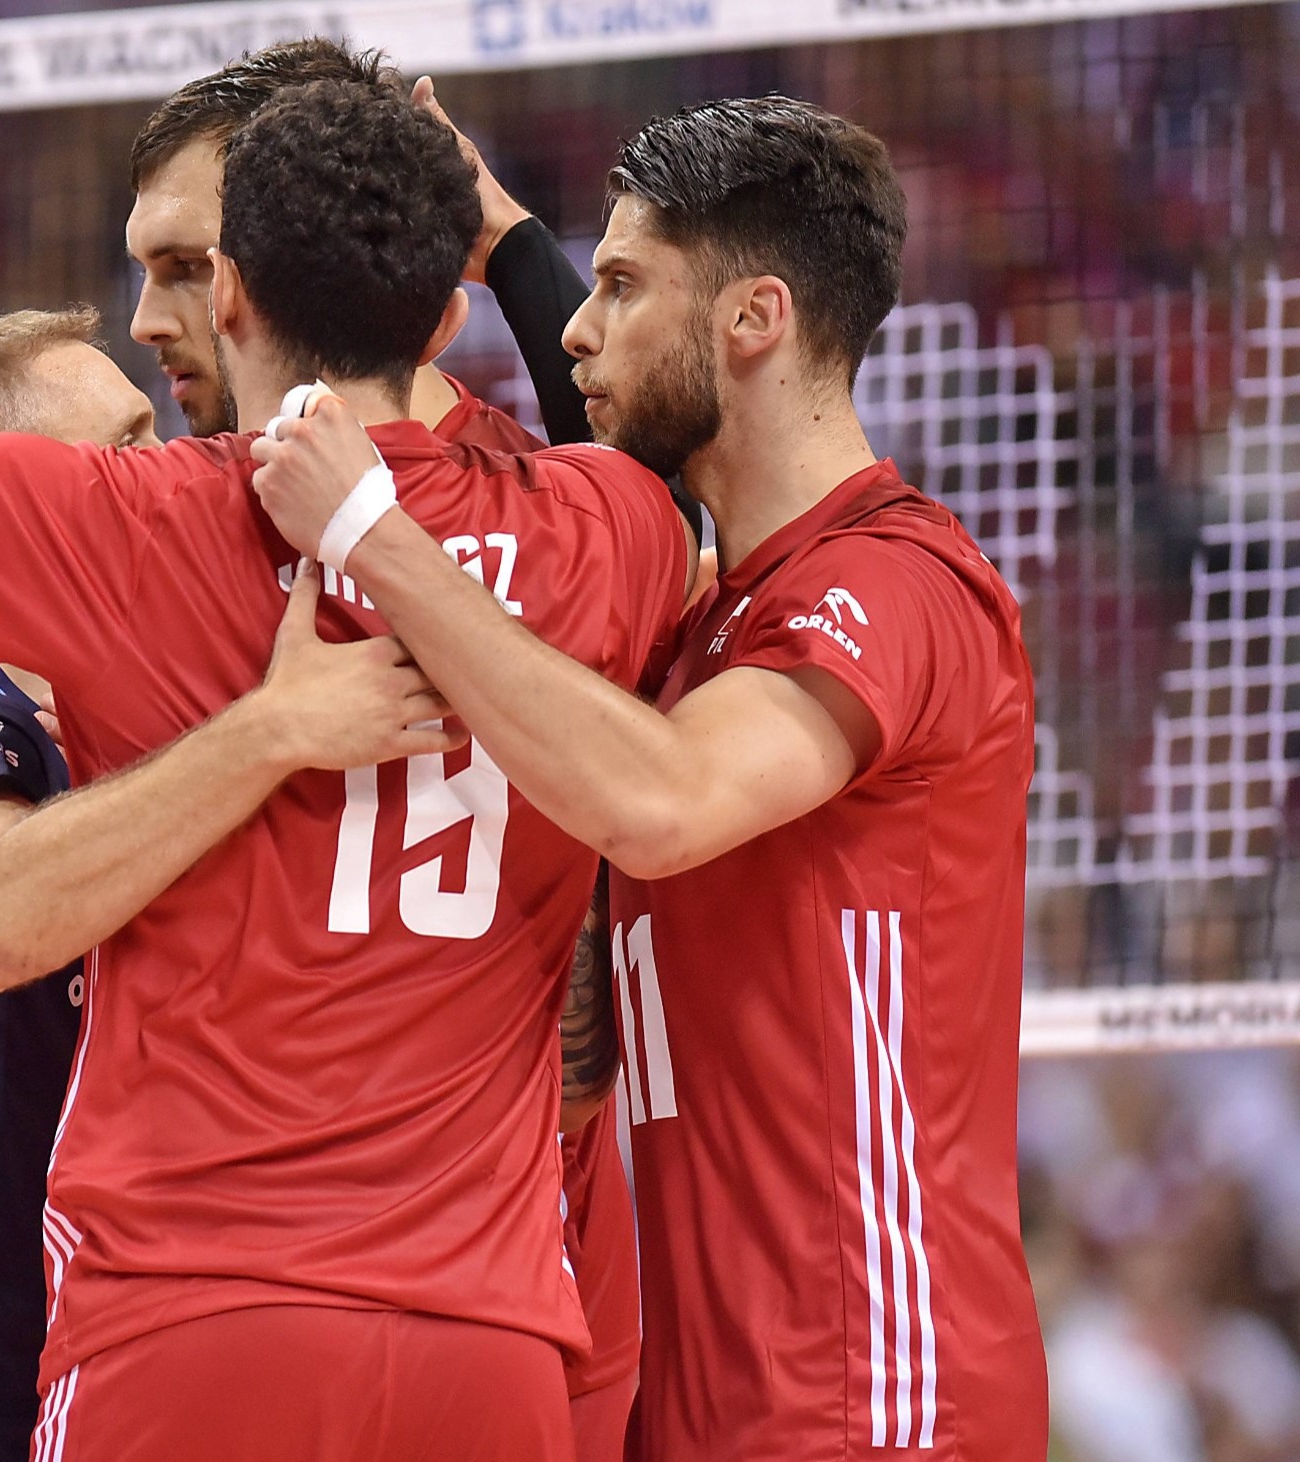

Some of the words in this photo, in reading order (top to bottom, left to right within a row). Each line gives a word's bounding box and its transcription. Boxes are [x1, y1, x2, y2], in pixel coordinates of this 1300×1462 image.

[787, 613, 863, 661] ORLEN
[327, 718, 510, 940] 19
[611, 913, 679, 1127] 11
